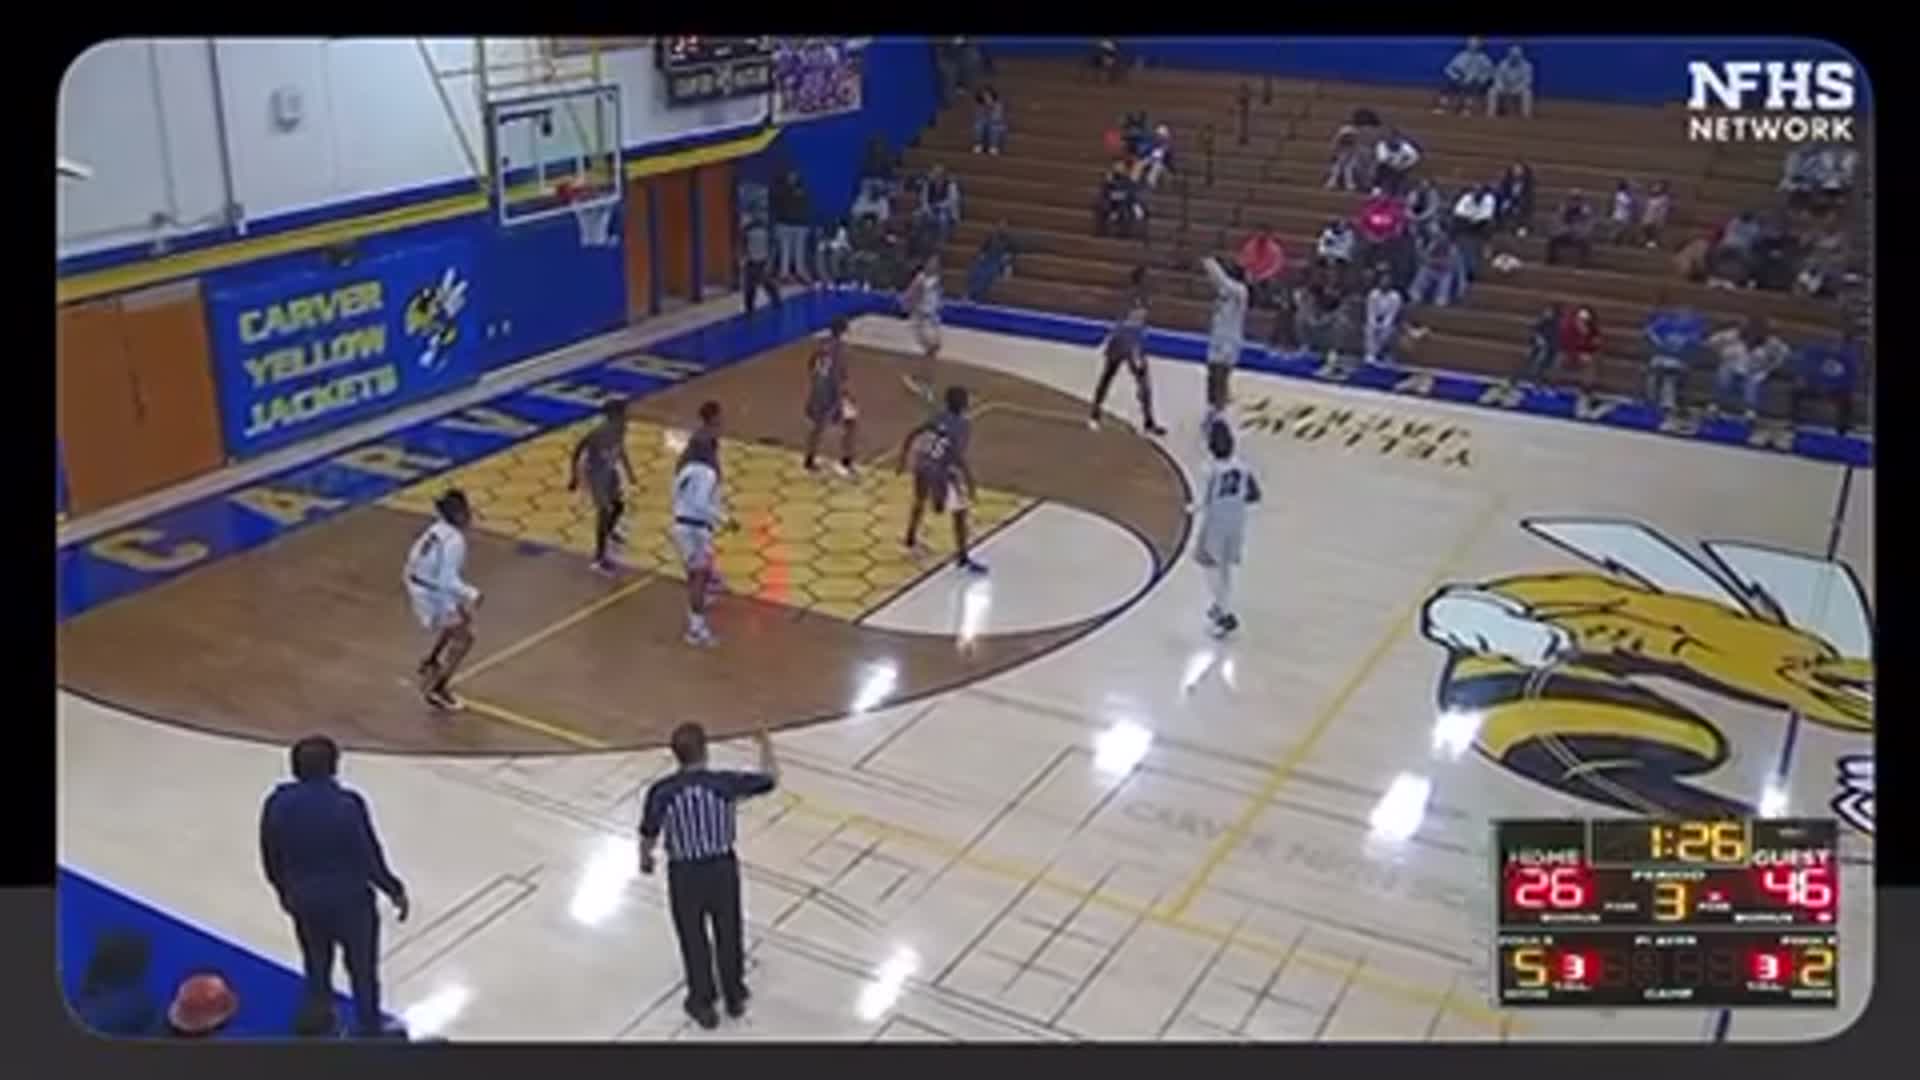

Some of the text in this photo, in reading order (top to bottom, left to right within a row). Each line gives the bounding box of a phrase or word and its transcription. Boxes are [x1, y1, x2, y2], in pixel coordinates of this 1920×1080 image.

[239, 280, 383, 344] CARVER
[244, 325, 386, 388] YELLOW
[244, 364, 397, 438] JACKETS
